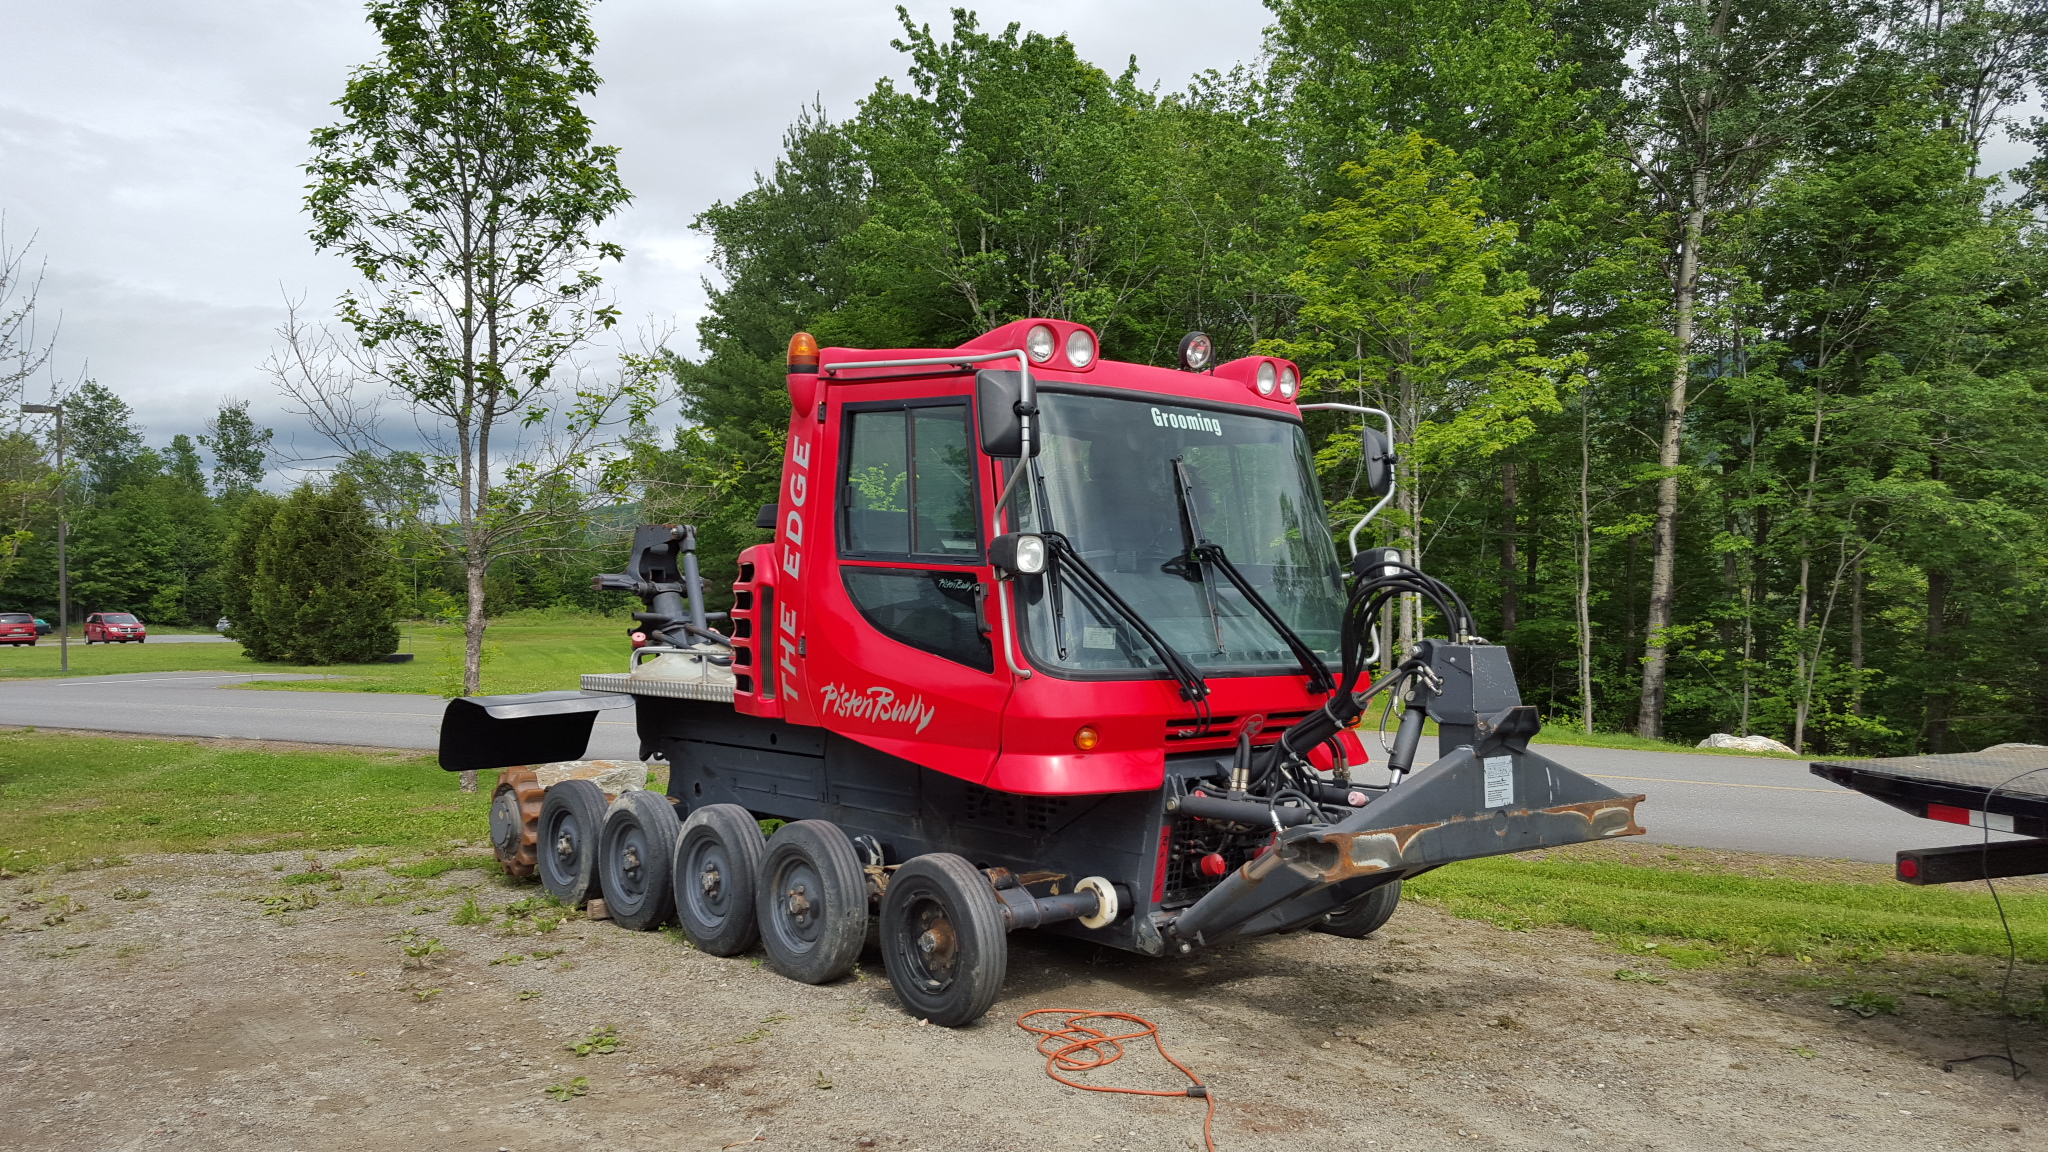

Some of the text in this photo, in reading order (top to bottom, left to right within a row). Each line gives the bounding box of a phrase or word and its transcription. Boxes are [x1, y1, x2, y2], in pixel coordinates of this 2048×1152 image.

[1150, 407, 1223, 437] Grooming
[780, 434, 811, 702] THE EDGE
[820, 681, 936, 735] PistenBully
